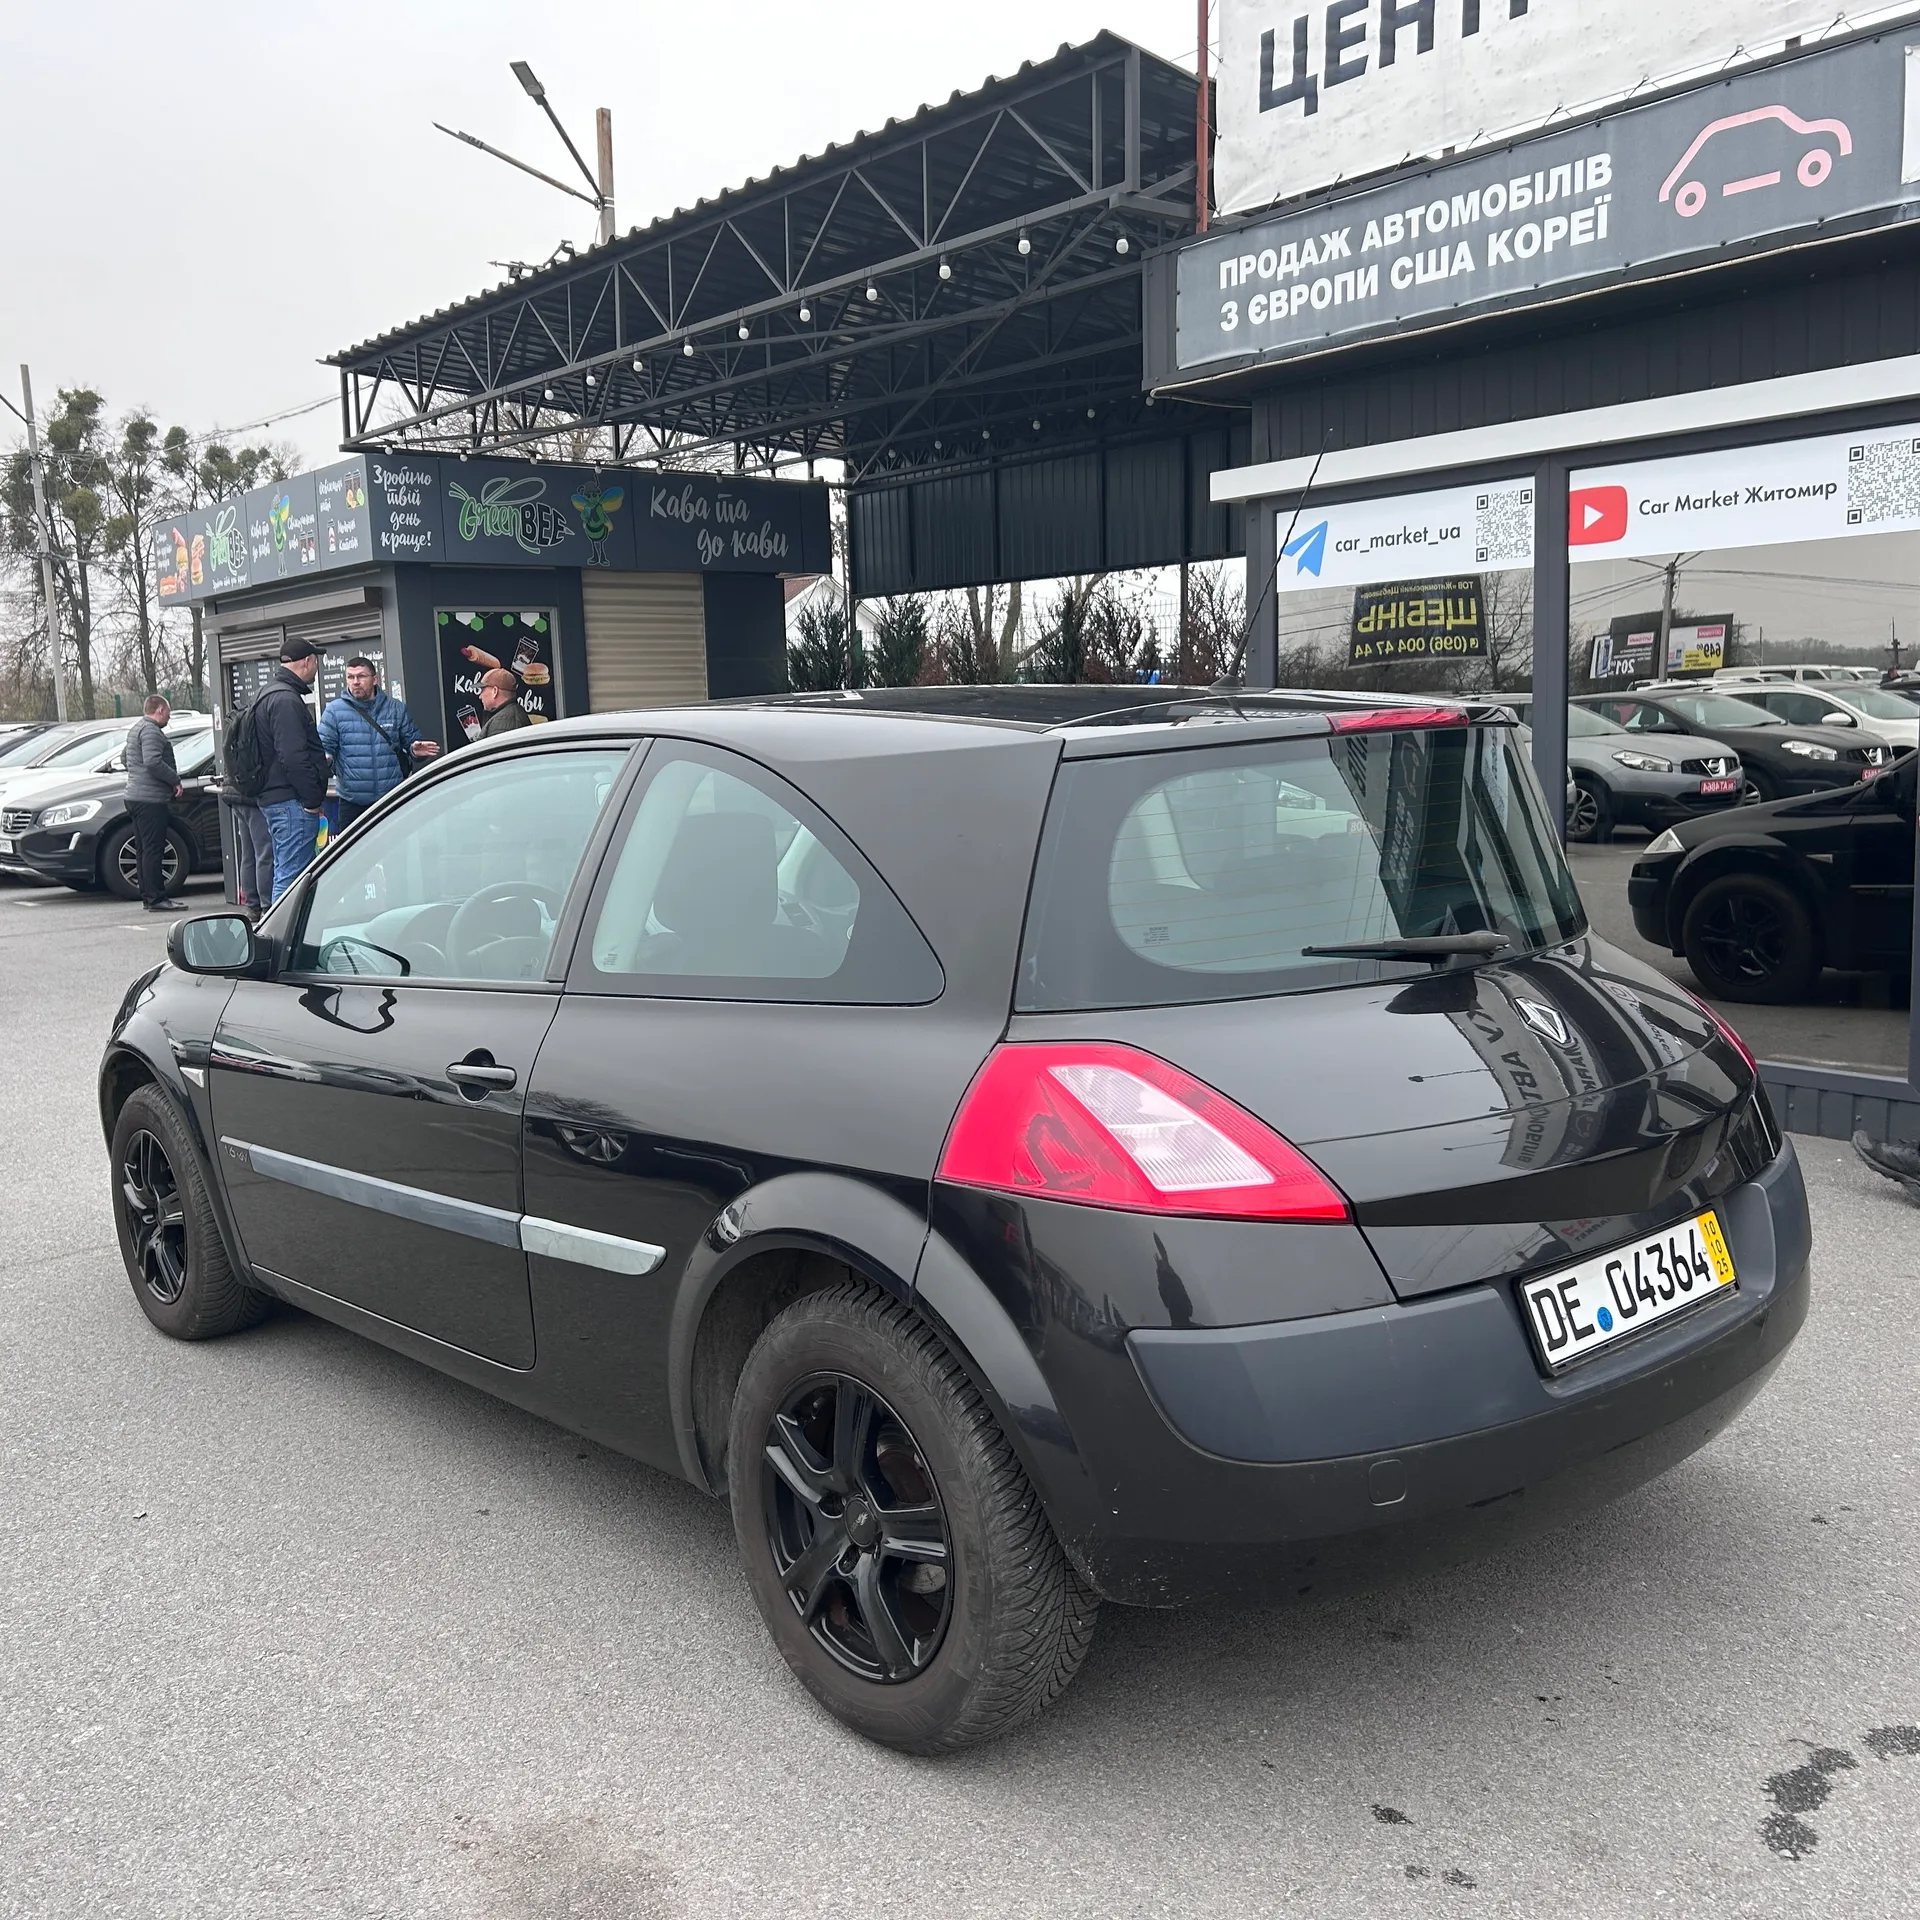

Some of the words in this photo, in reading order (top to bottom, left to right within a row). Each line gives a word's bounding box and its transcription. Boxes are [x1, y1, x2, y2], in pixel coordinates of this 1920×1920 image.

[1259, 0, 1528, 117] ЦЕН
[1220, 227, 1352, 290] ПРОДАЖ
[1360, 153, 1613, 253] АВТОМОБІЛІВ
[1220, 300, 1239, 332] З
[1248, 264, 1379, 325] ЄВРОПИ
[1390, 240, 1476, 290] США
[1487, 193, 1612, 267] КОРЕЇ
[372, 464, 432, 491] Зробимо
[386, 488, 422, 507] твій
[650, 483, 711, 523] Кава
[715, 493, 750, 524] та
[1639, 499, 1669, 515] Car
[1674, 490, 1739, 512] Market
[1744, 482, 1838, 504] Житомир
[390, 511, 421, 532] день
[380, 531, 432, 554] краще!
[697, 528, 725, 565] до
[731, 520, 789, 559] кави
[1335, 526, 1461, 553] car_market_ua
[1703, 1220, 1716, 1238] 10
[1710, 1239, 1723, 1256] 10
[1716, 1257, 1729, 1276] 25
[1530, 1277, 1595, 1352] DE
[1605, 1229, 1711, 1319] 04364
